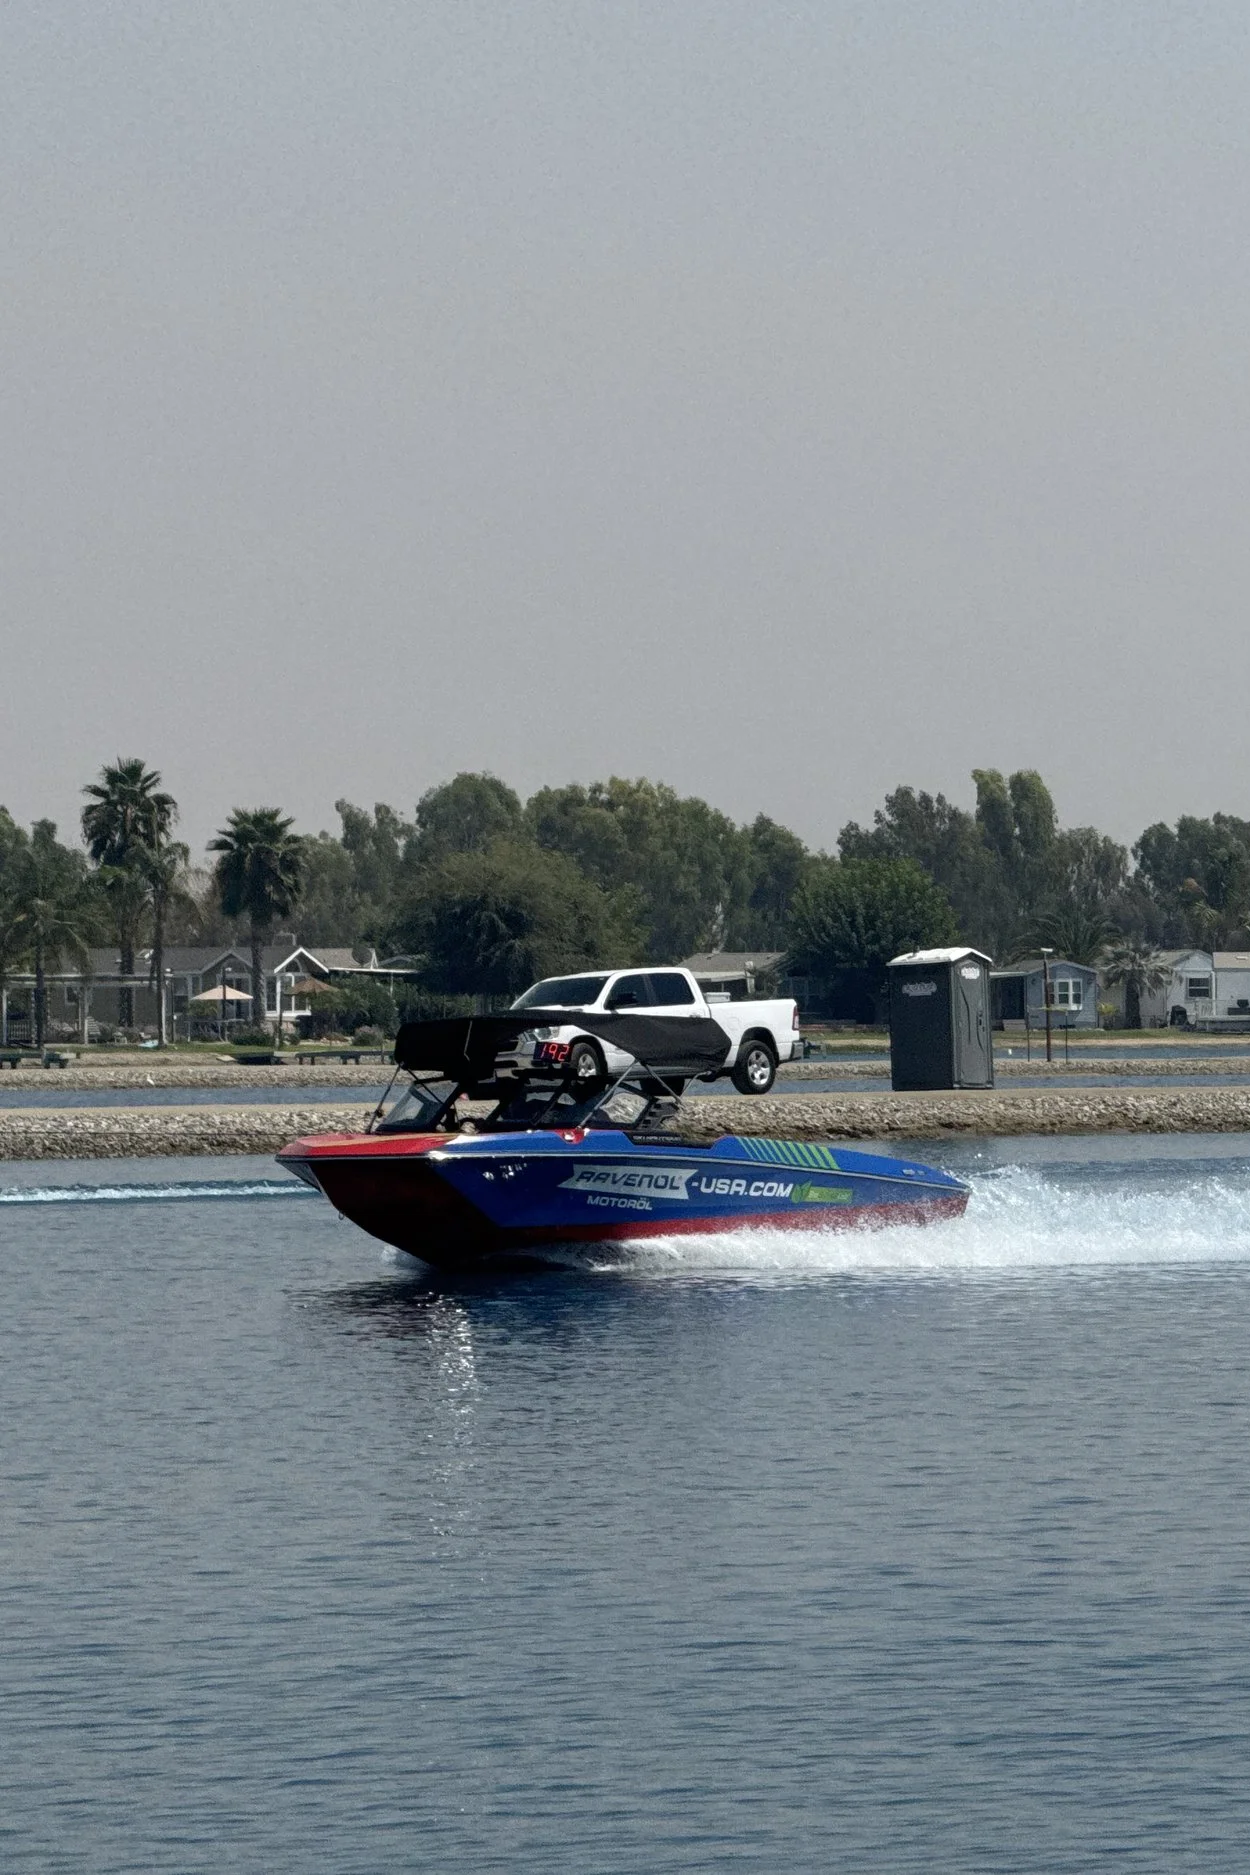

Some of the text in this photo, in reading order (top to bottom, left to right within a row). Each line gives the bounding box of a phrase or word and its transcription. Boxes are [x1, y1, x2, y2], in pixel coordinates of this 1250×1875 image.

[540, 1042, 570, 1062] 192
[575, 1170, 682, 1191] RAVENOL
[586, 1194, 653, 1211] MOTORÖL
